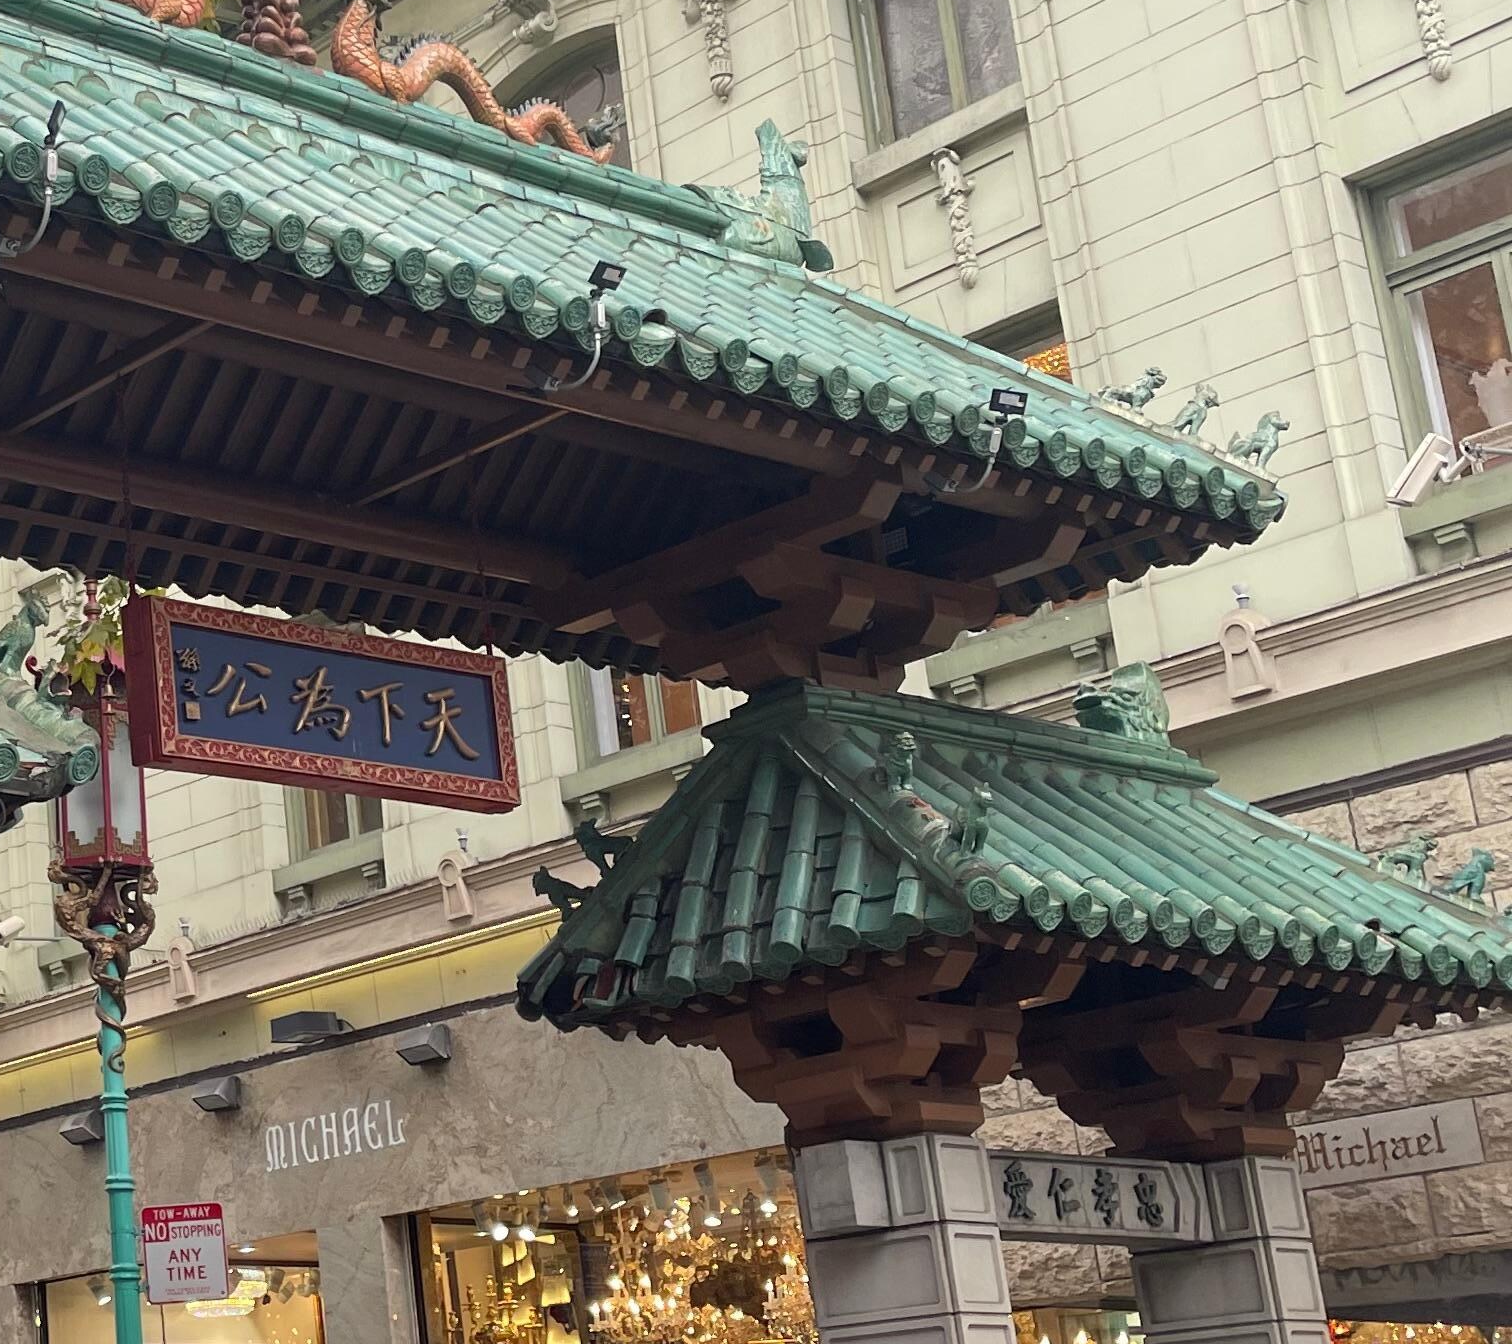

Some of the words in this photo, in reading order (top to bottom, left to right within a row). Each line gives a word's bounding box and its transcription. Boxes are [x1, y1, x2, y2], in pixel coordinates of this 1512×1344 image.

[265, 1099, 406, 1173] MICHAEL
[1292, 1115, 1447, 1175] Michael
[152, 1206, 211, 1221] TOW-AWAY
[144, 1222, 168, 1242] NO
[170, 1223, 222, 1240] STOPPING
[168, 1247, 202, 1264] ANY
[166, 1265, 208, 1282] TIME
